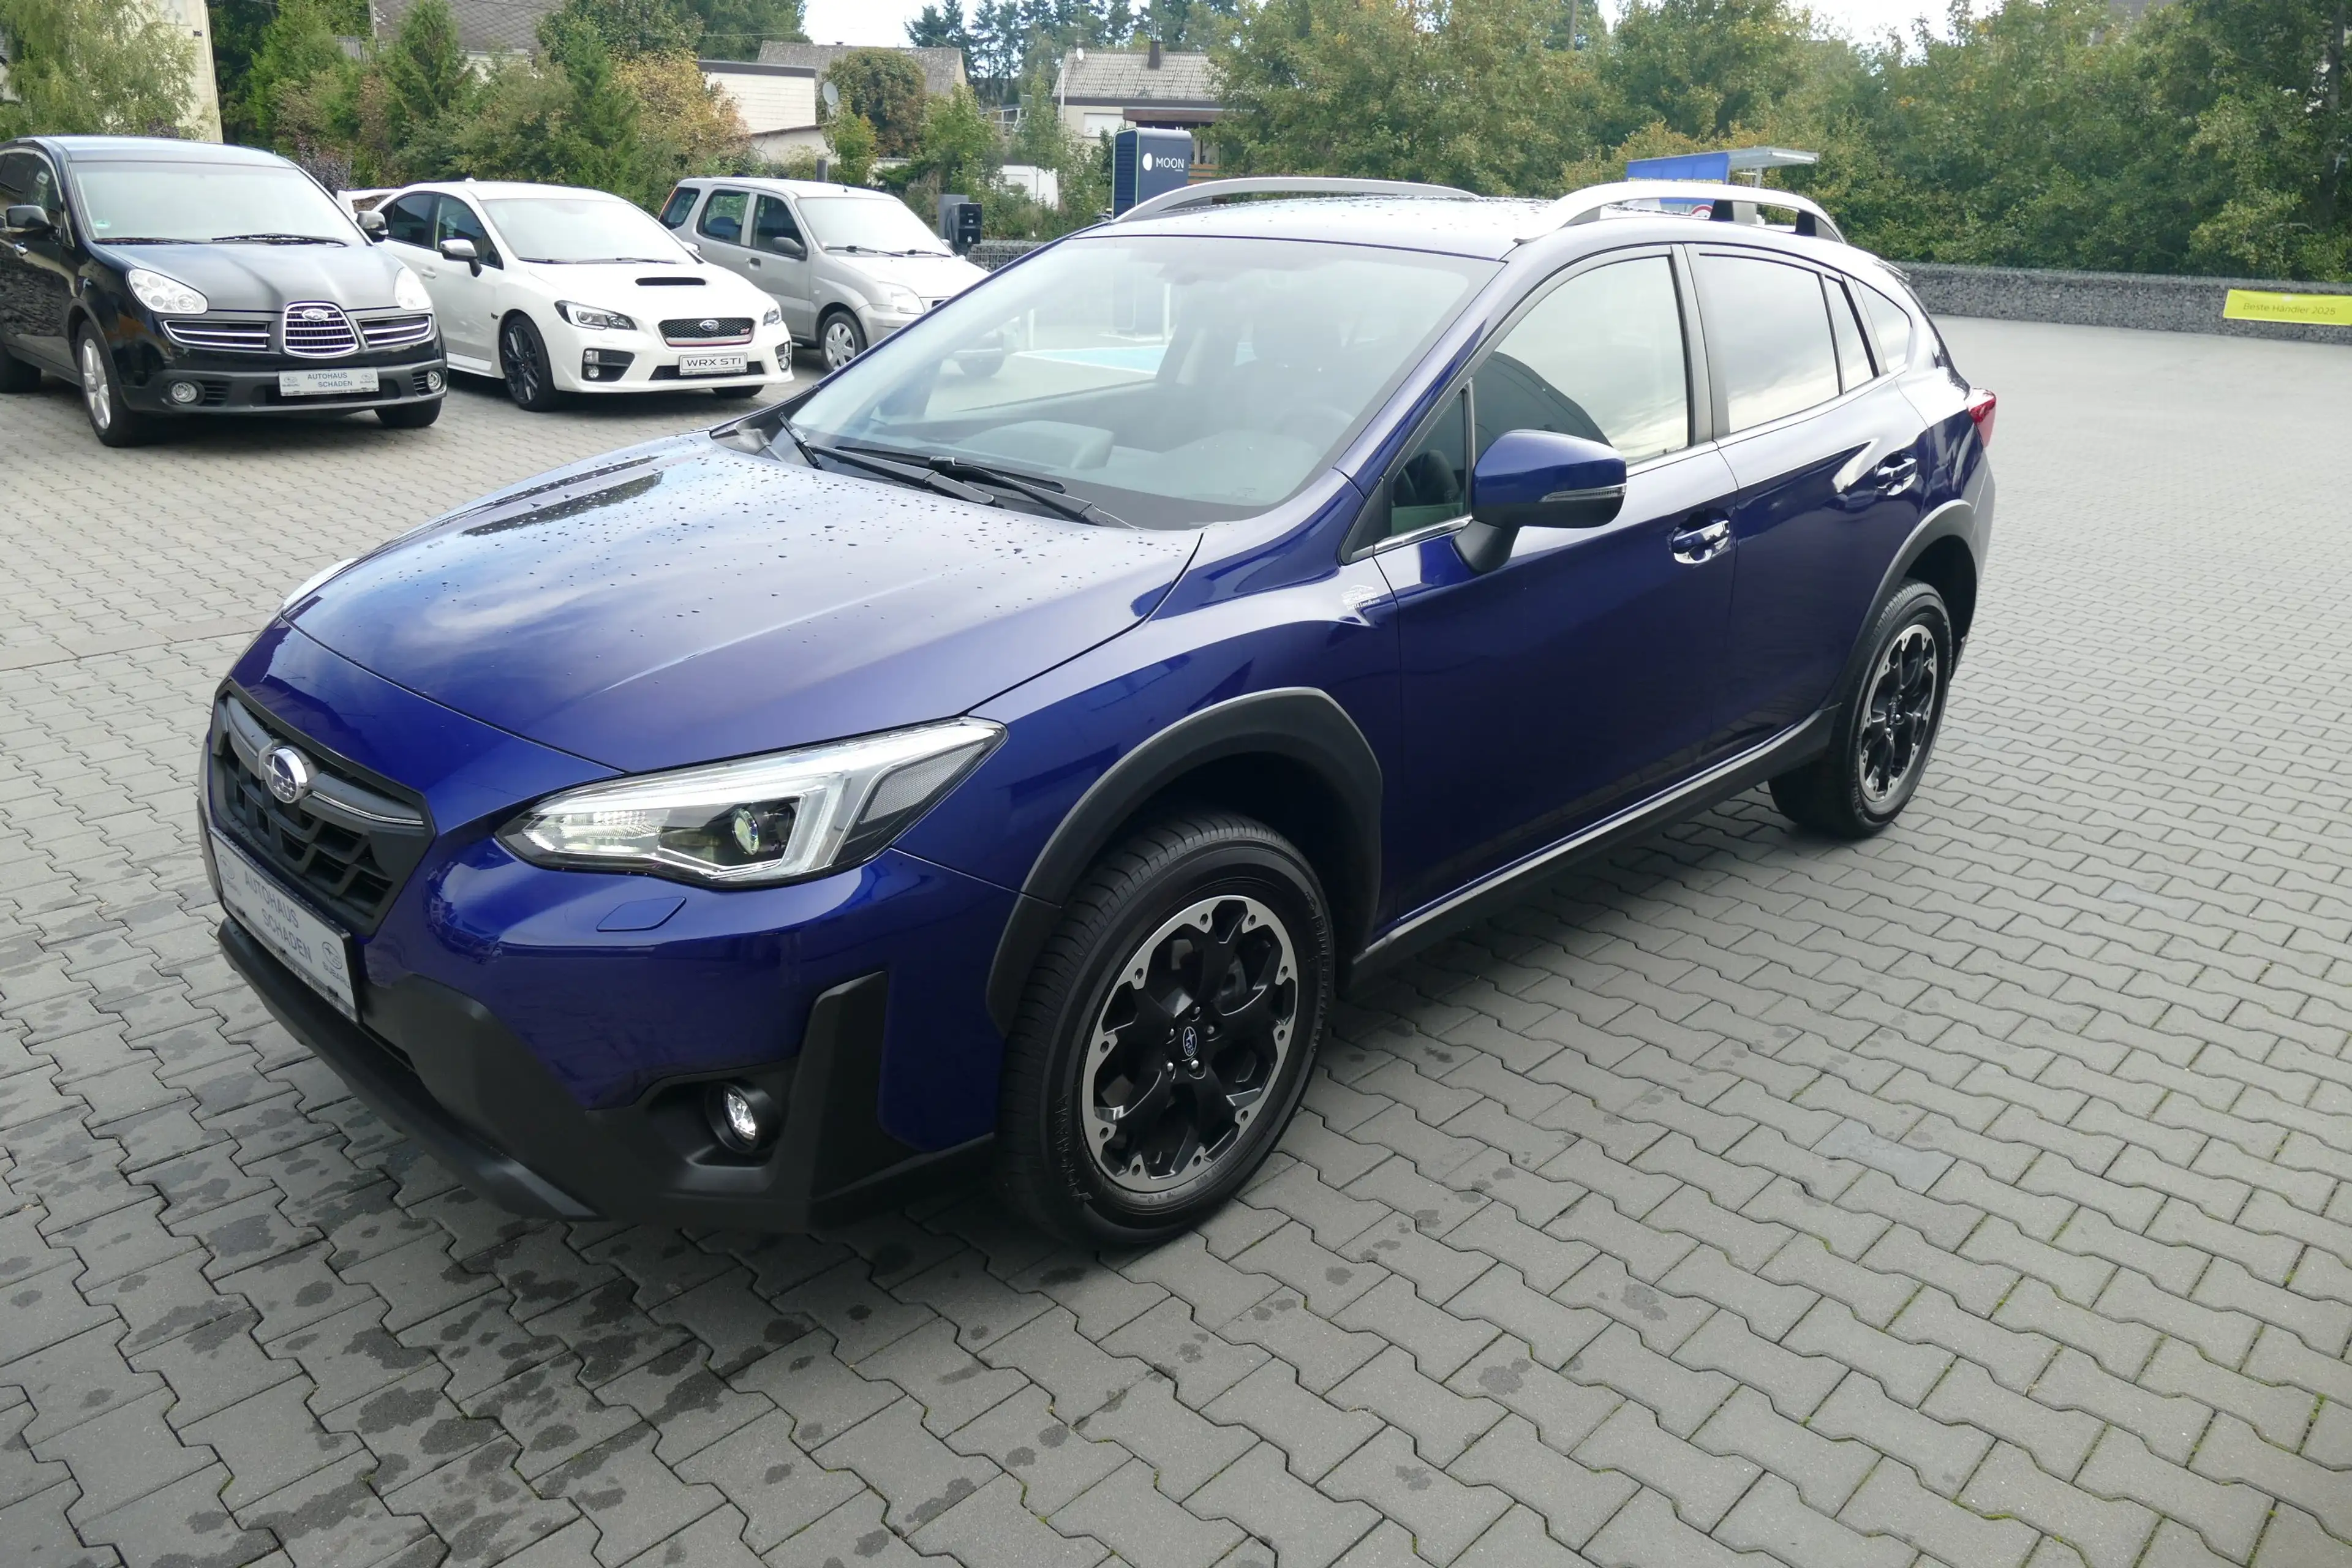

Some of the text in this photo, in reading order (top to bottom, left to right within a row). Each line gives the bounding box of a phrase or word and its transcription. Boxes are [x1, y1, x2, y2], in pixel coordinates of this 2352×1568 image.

[1156, 157, 1185, 168] MOON
[2243, 303, 2270, 311] Beste
[2312, 306, 2336, 315] 2025
[244, 870, 300, 929] AUTOHAUS
[262, 908, 313, 964] SCHADEN
